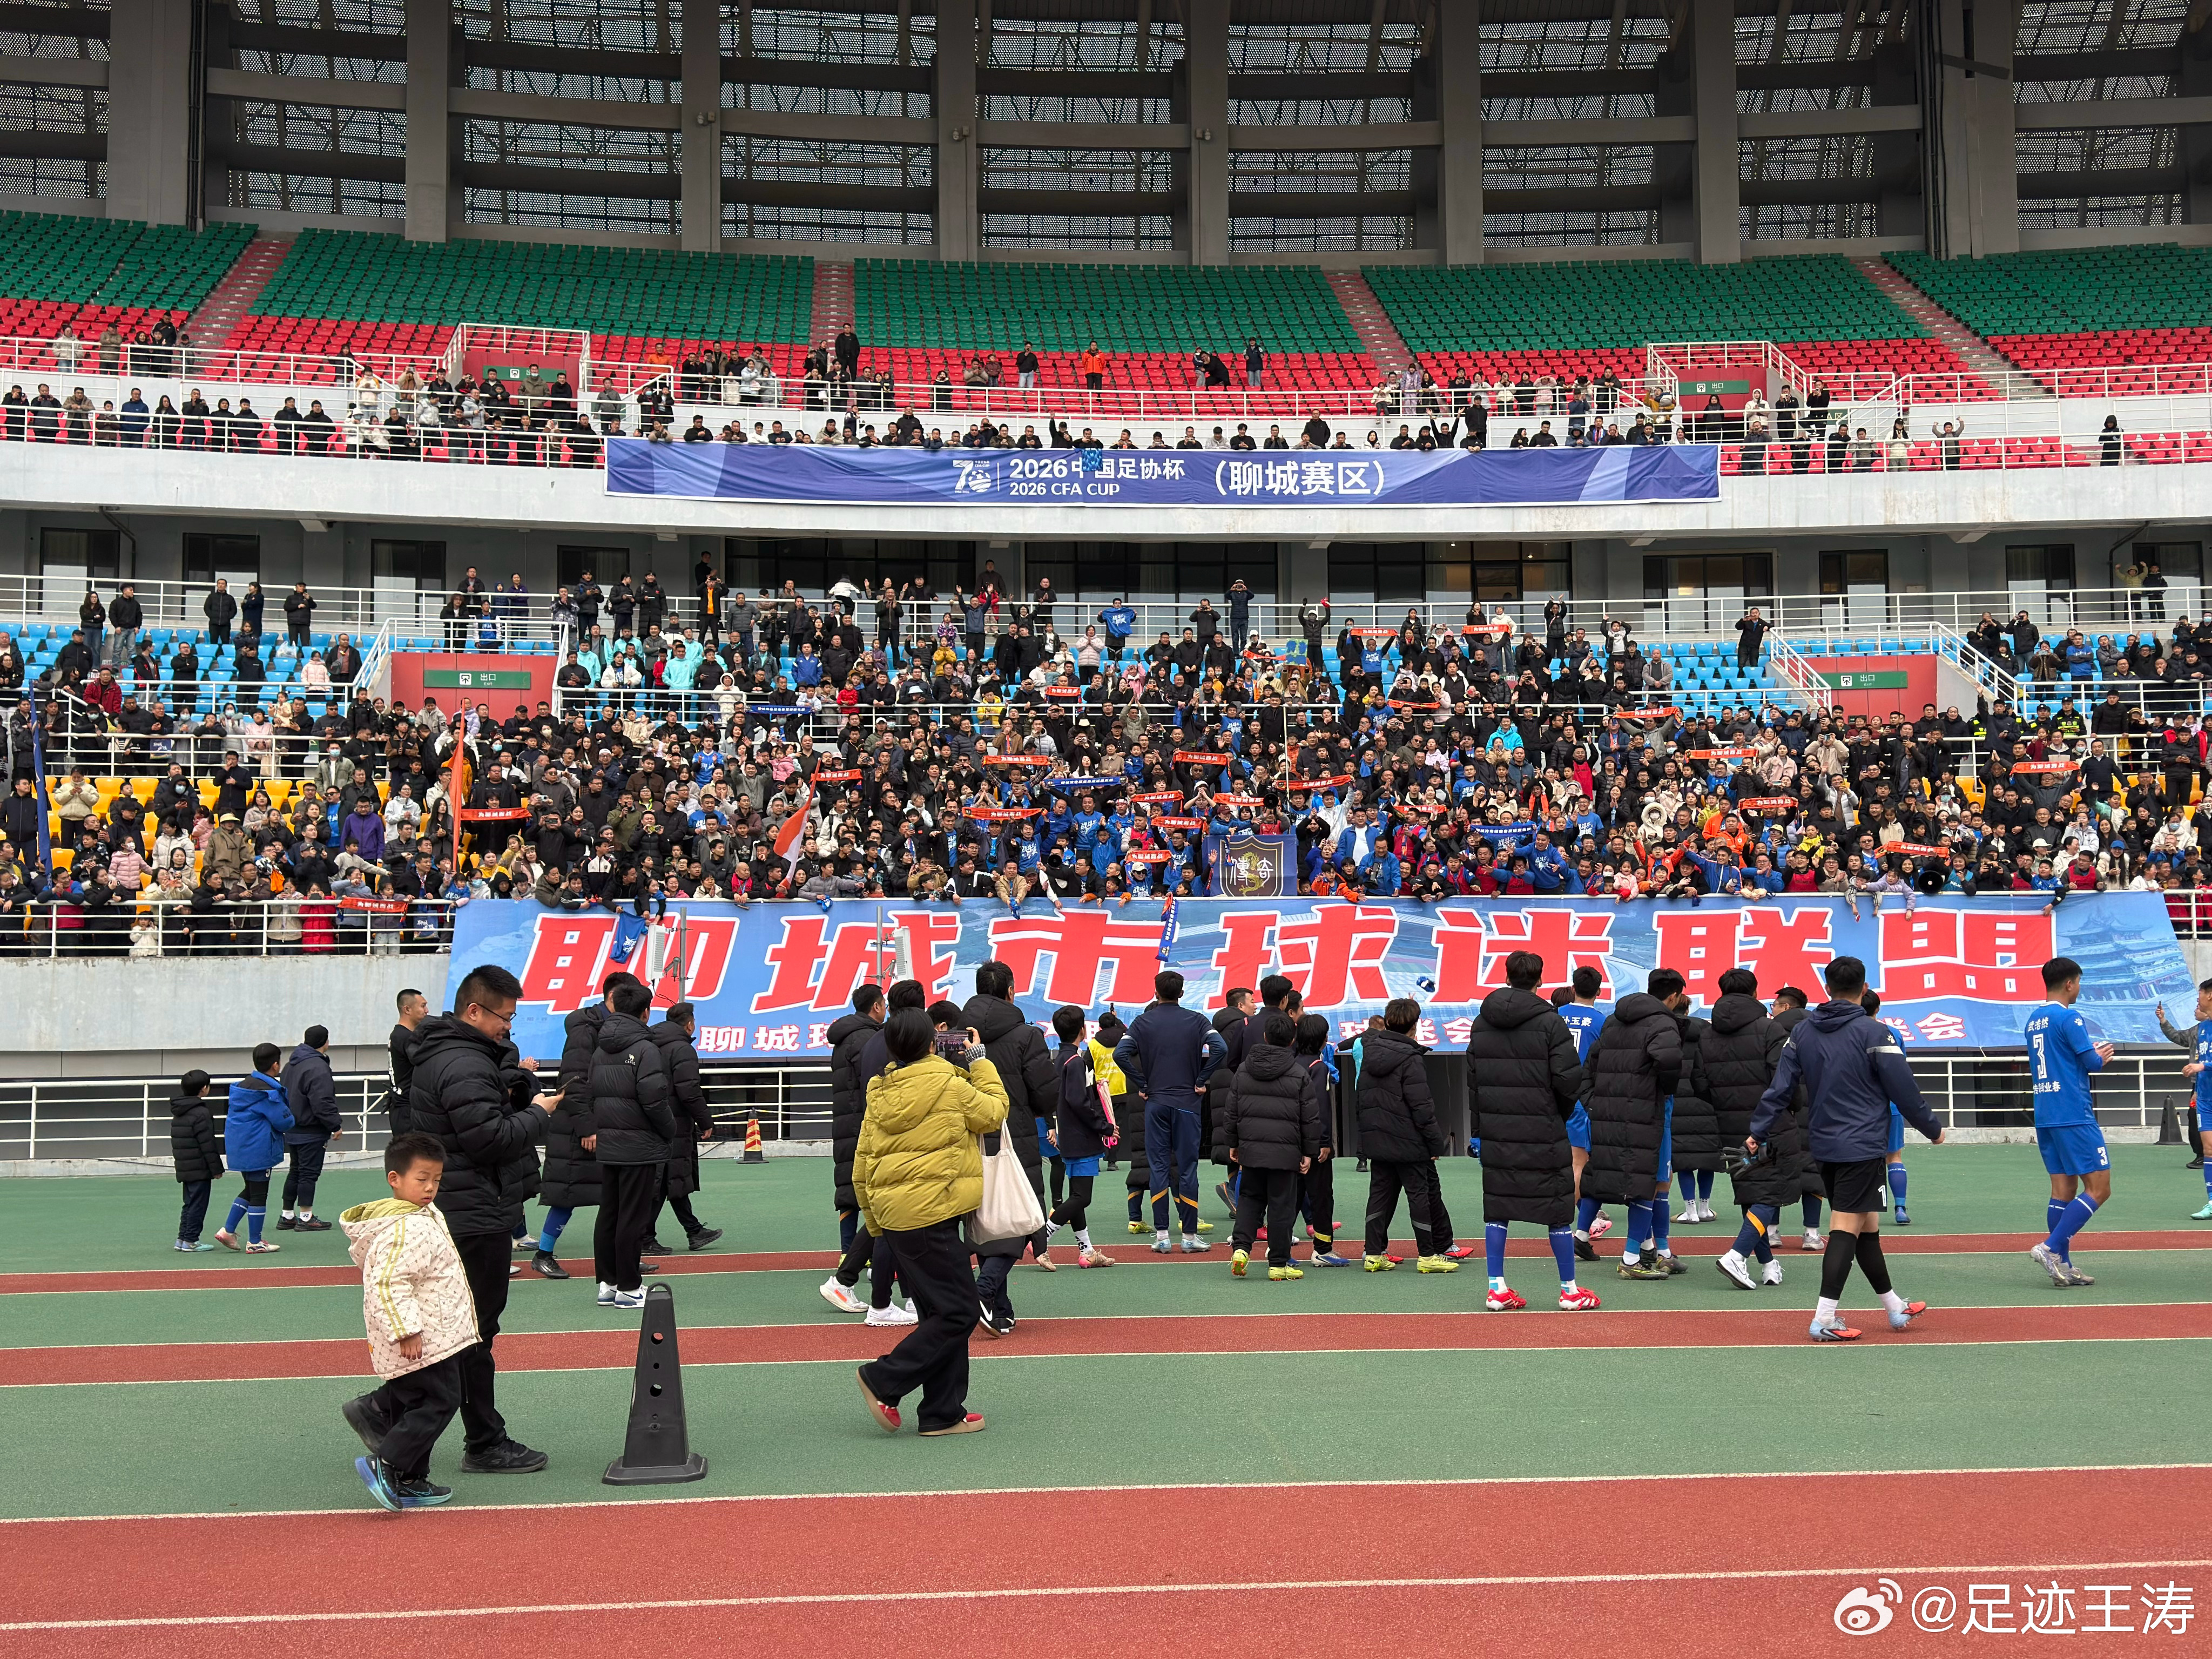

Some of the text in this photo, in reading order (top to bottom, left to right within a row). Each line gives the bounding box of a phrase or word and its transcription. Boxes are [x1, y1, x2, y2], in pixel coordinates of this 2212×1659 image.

[1009, 482, 1120, 496] 2026 CFA CUP
[1215, 460, 1384, 496] （聊城赛区）
[480, 673, 496, 682] 出口
[517, 903, 2057, 1014] 聊城市球迷联盟
[2033, 1033, 2047, 1080] 3
[2098, 1147, 2108, 1165] 3
